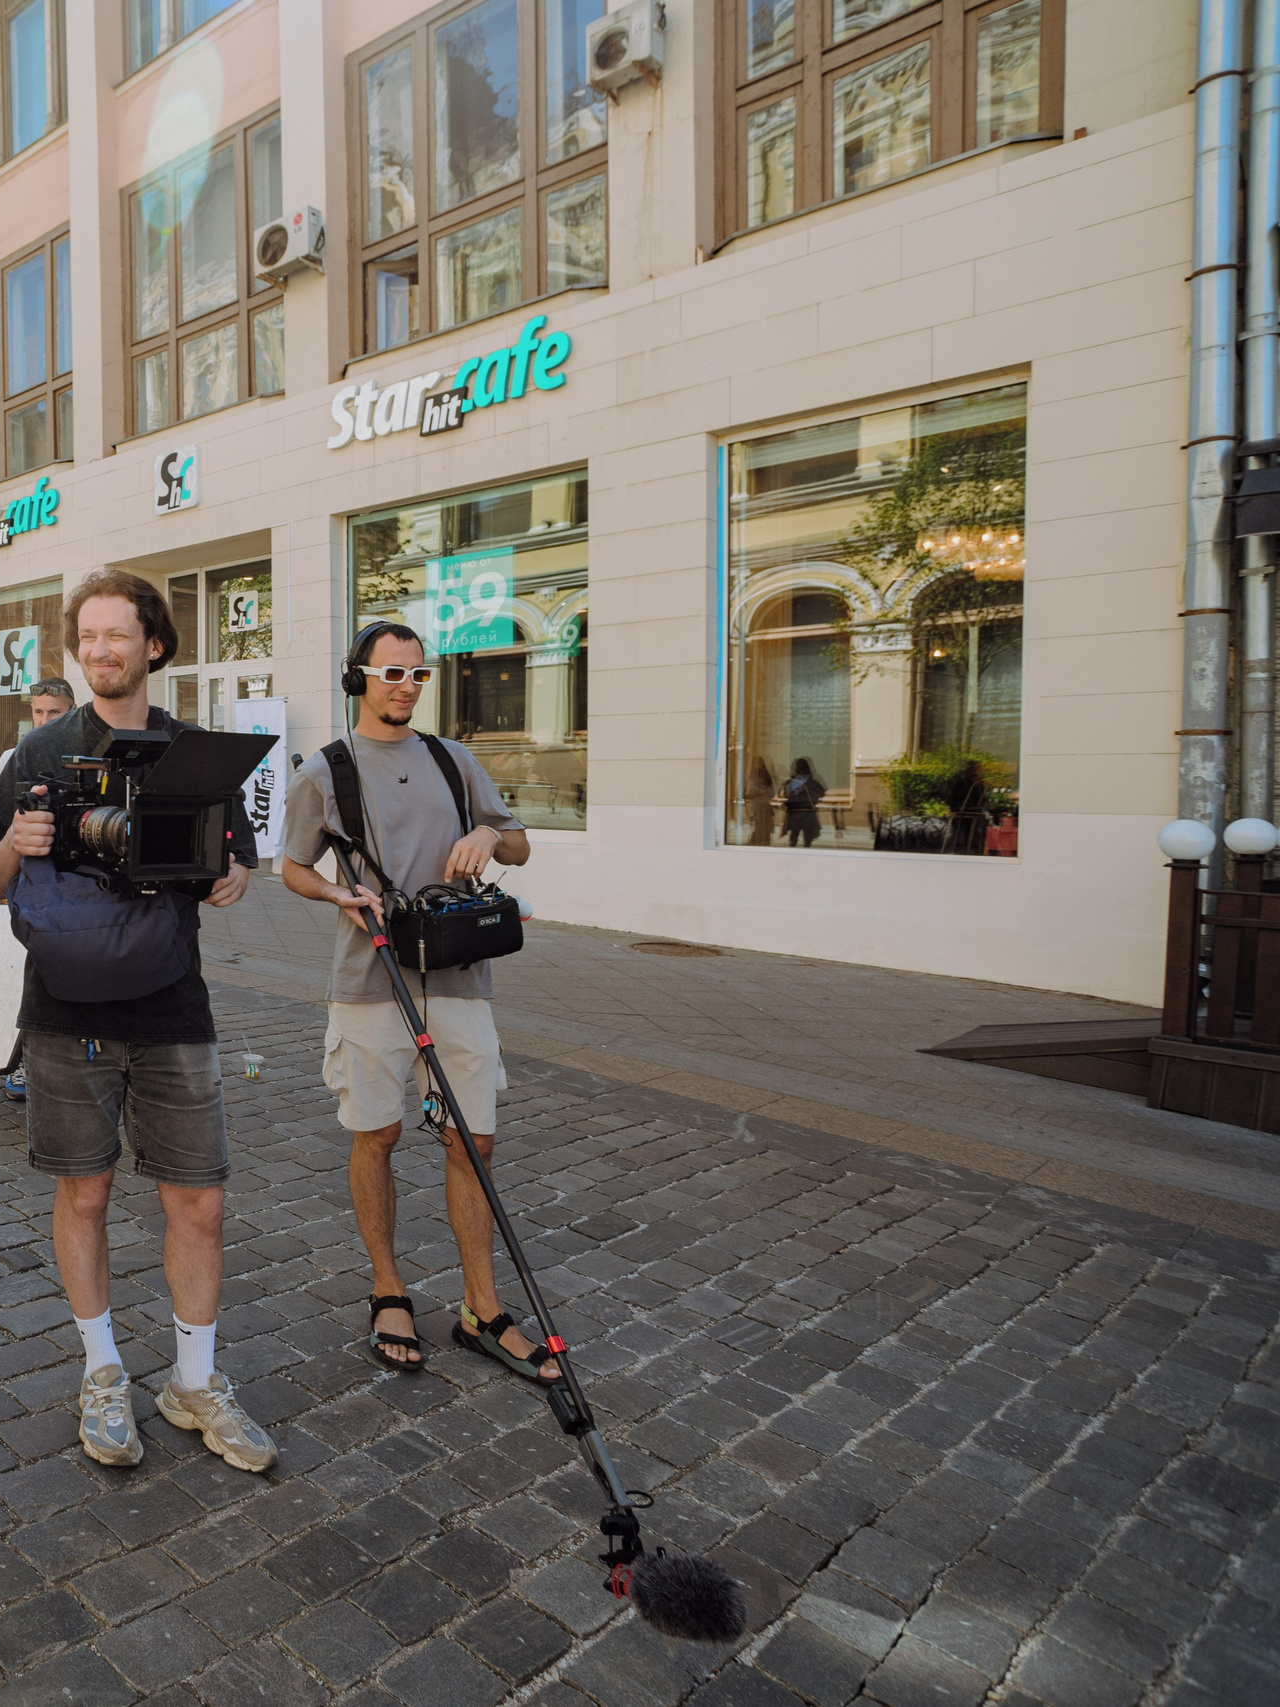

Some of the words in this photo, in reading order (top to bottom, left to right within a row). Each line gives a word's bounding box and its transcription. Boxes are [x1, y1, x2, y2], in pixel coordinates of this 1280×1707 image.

[326, 371, 443, 449] Star
[422, 394, 460, 434] hit
[452, 315, 571, 413] cafe
[5, 477, 59, 536] cafe
[446, 560, 477, 572] меню
[480, 557, 493, 567] от
[434, 572, 507, 631] 59
[442, 630, 497, 651] рублей
[250, 778, 270, 836] Star
[262, 769, 274, 789] hit
[480, 917, 496, 925] ORCA
